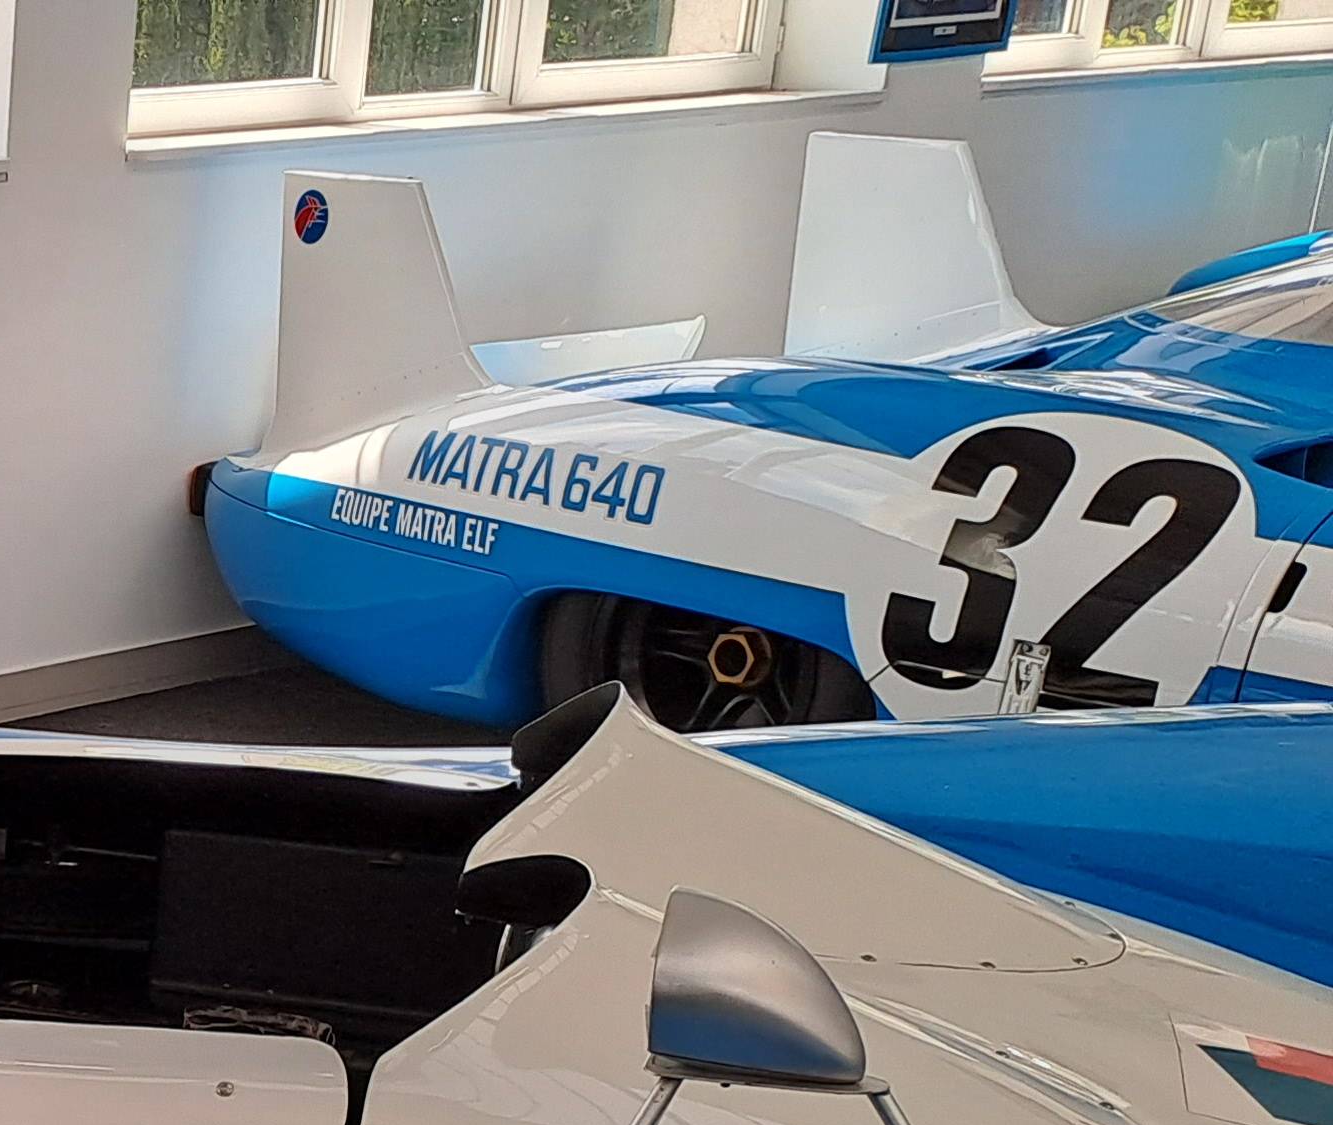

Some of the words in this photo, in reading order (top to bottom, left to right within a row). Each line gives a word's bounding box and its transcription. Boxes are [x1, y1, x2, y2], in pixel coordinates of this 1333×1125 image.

[331, 488, 394, 532] EQUIPE
[395, 501, 458, 548] MATRA
[461, 518, 500, 555] ELF
[407, 430, 555, 506] MATRA
[561, 453, 667, 526] 640
[882, 426, 1241, 710] 32
